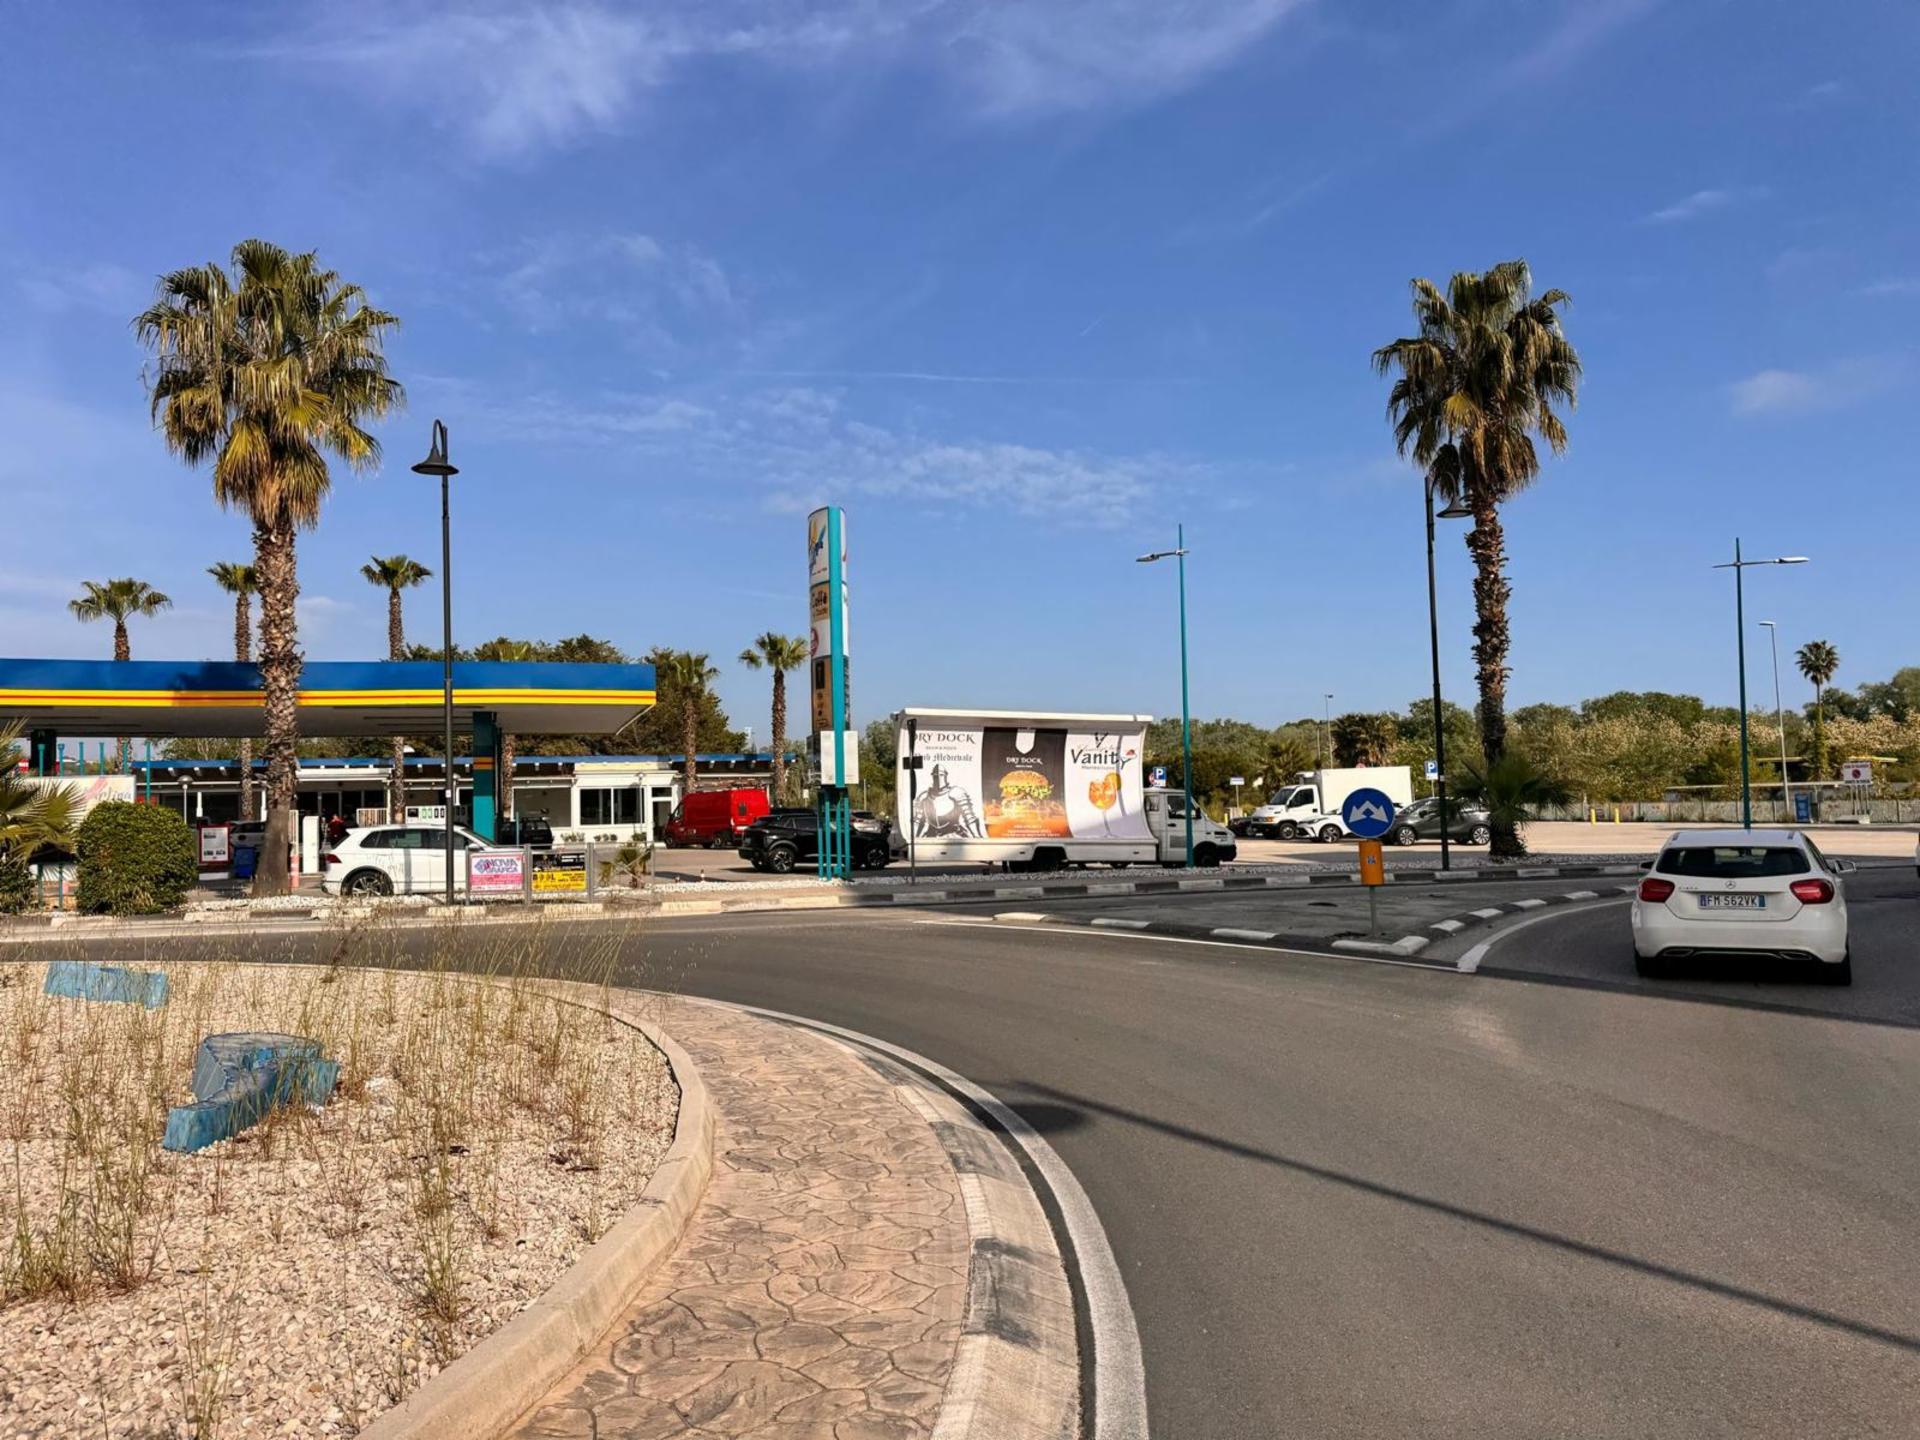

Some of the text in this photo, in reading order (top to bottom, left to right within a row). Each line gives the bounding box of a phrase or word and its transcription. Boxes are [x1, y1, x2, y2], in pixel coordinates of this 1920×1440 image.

[937, 733, 976, 745] DOCK
[1020, 757, 1044, 766] DOCK
[1071, 748, 1134, 770] Vanity
[1428, 762, 1435, 773] P
[1156, 768, 1164, 779] P
[1707, 894, 1721, 906] FM
